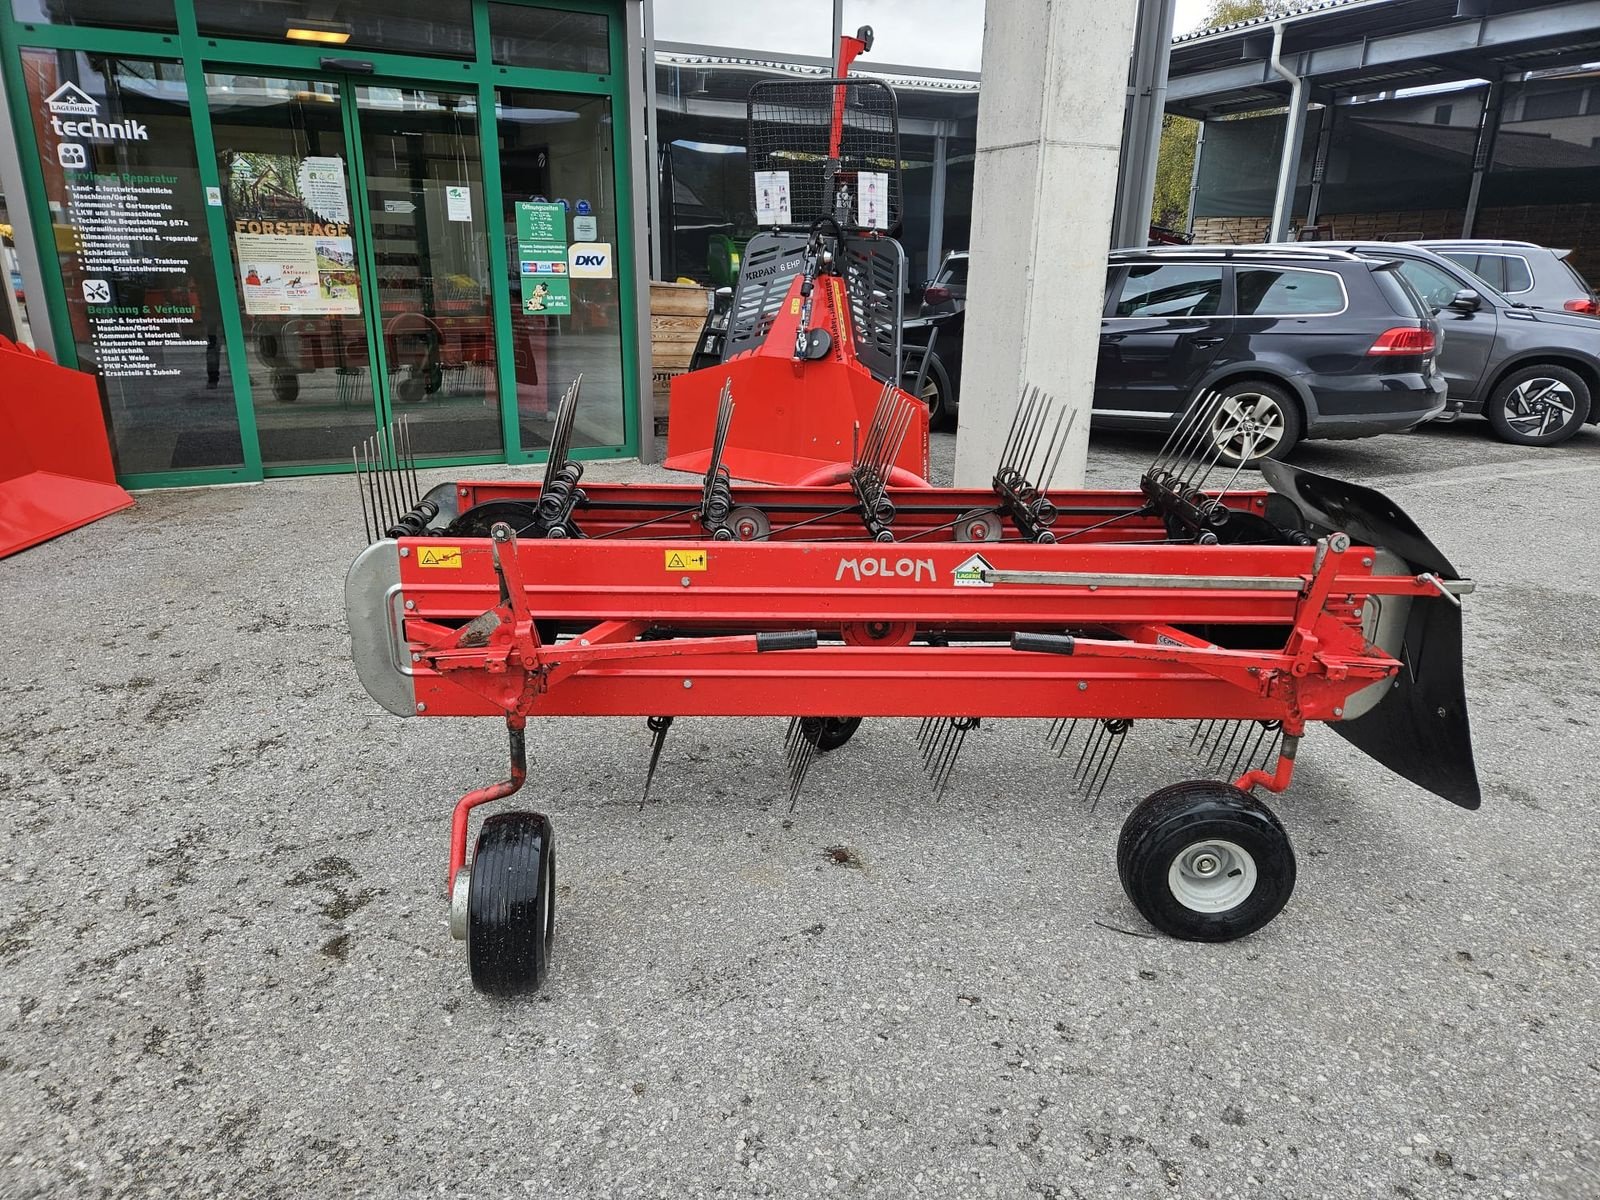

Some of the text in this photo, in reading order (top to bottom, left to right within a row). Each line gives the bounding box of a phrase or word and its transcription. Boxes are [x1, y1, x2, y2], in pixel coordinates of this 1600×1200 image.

[52, 105, 95, 113] LAGERHAUS
[50, 115, 148, 140] technik
[110, 172, 118, 181] &
[123, 173, 178, 184] Reparatur
[71, 184, 93, 192] Land-
[102, 185, 173, 194] forstwirtschaftliche
[73, 193, 138, 201] Maschinen/Geräte
[74, 200, 116, 208] Kommunal-
[125, 202, 173, 210] Gartengeräte
[522, 203, 559, 211] Öffnungszeiten
[118, 218, 168, 227] Begutachtung
[235, 220, 348, 237] FORSTTAGE
[80, 233, 154, 242] Klimaanlagenservice
[82, 241, 130, 249] Reifenservice
[575, 255, 605, 266] DKV
[745, 265, 777, 281] KRPAN
[786, 260, 801, 270] EHP
[88, 305, 196, 315] Beratung & Verkauf
[825, 278, 843, 362] salzburger-lagerhaus.at
[97, 324, 160, 332] Maschinen/Geräte
[144, 331, 181, 339] Motoristik
[153, 368, 181, 376] Zubehör
[835, 557, 937, 582] MOLON
